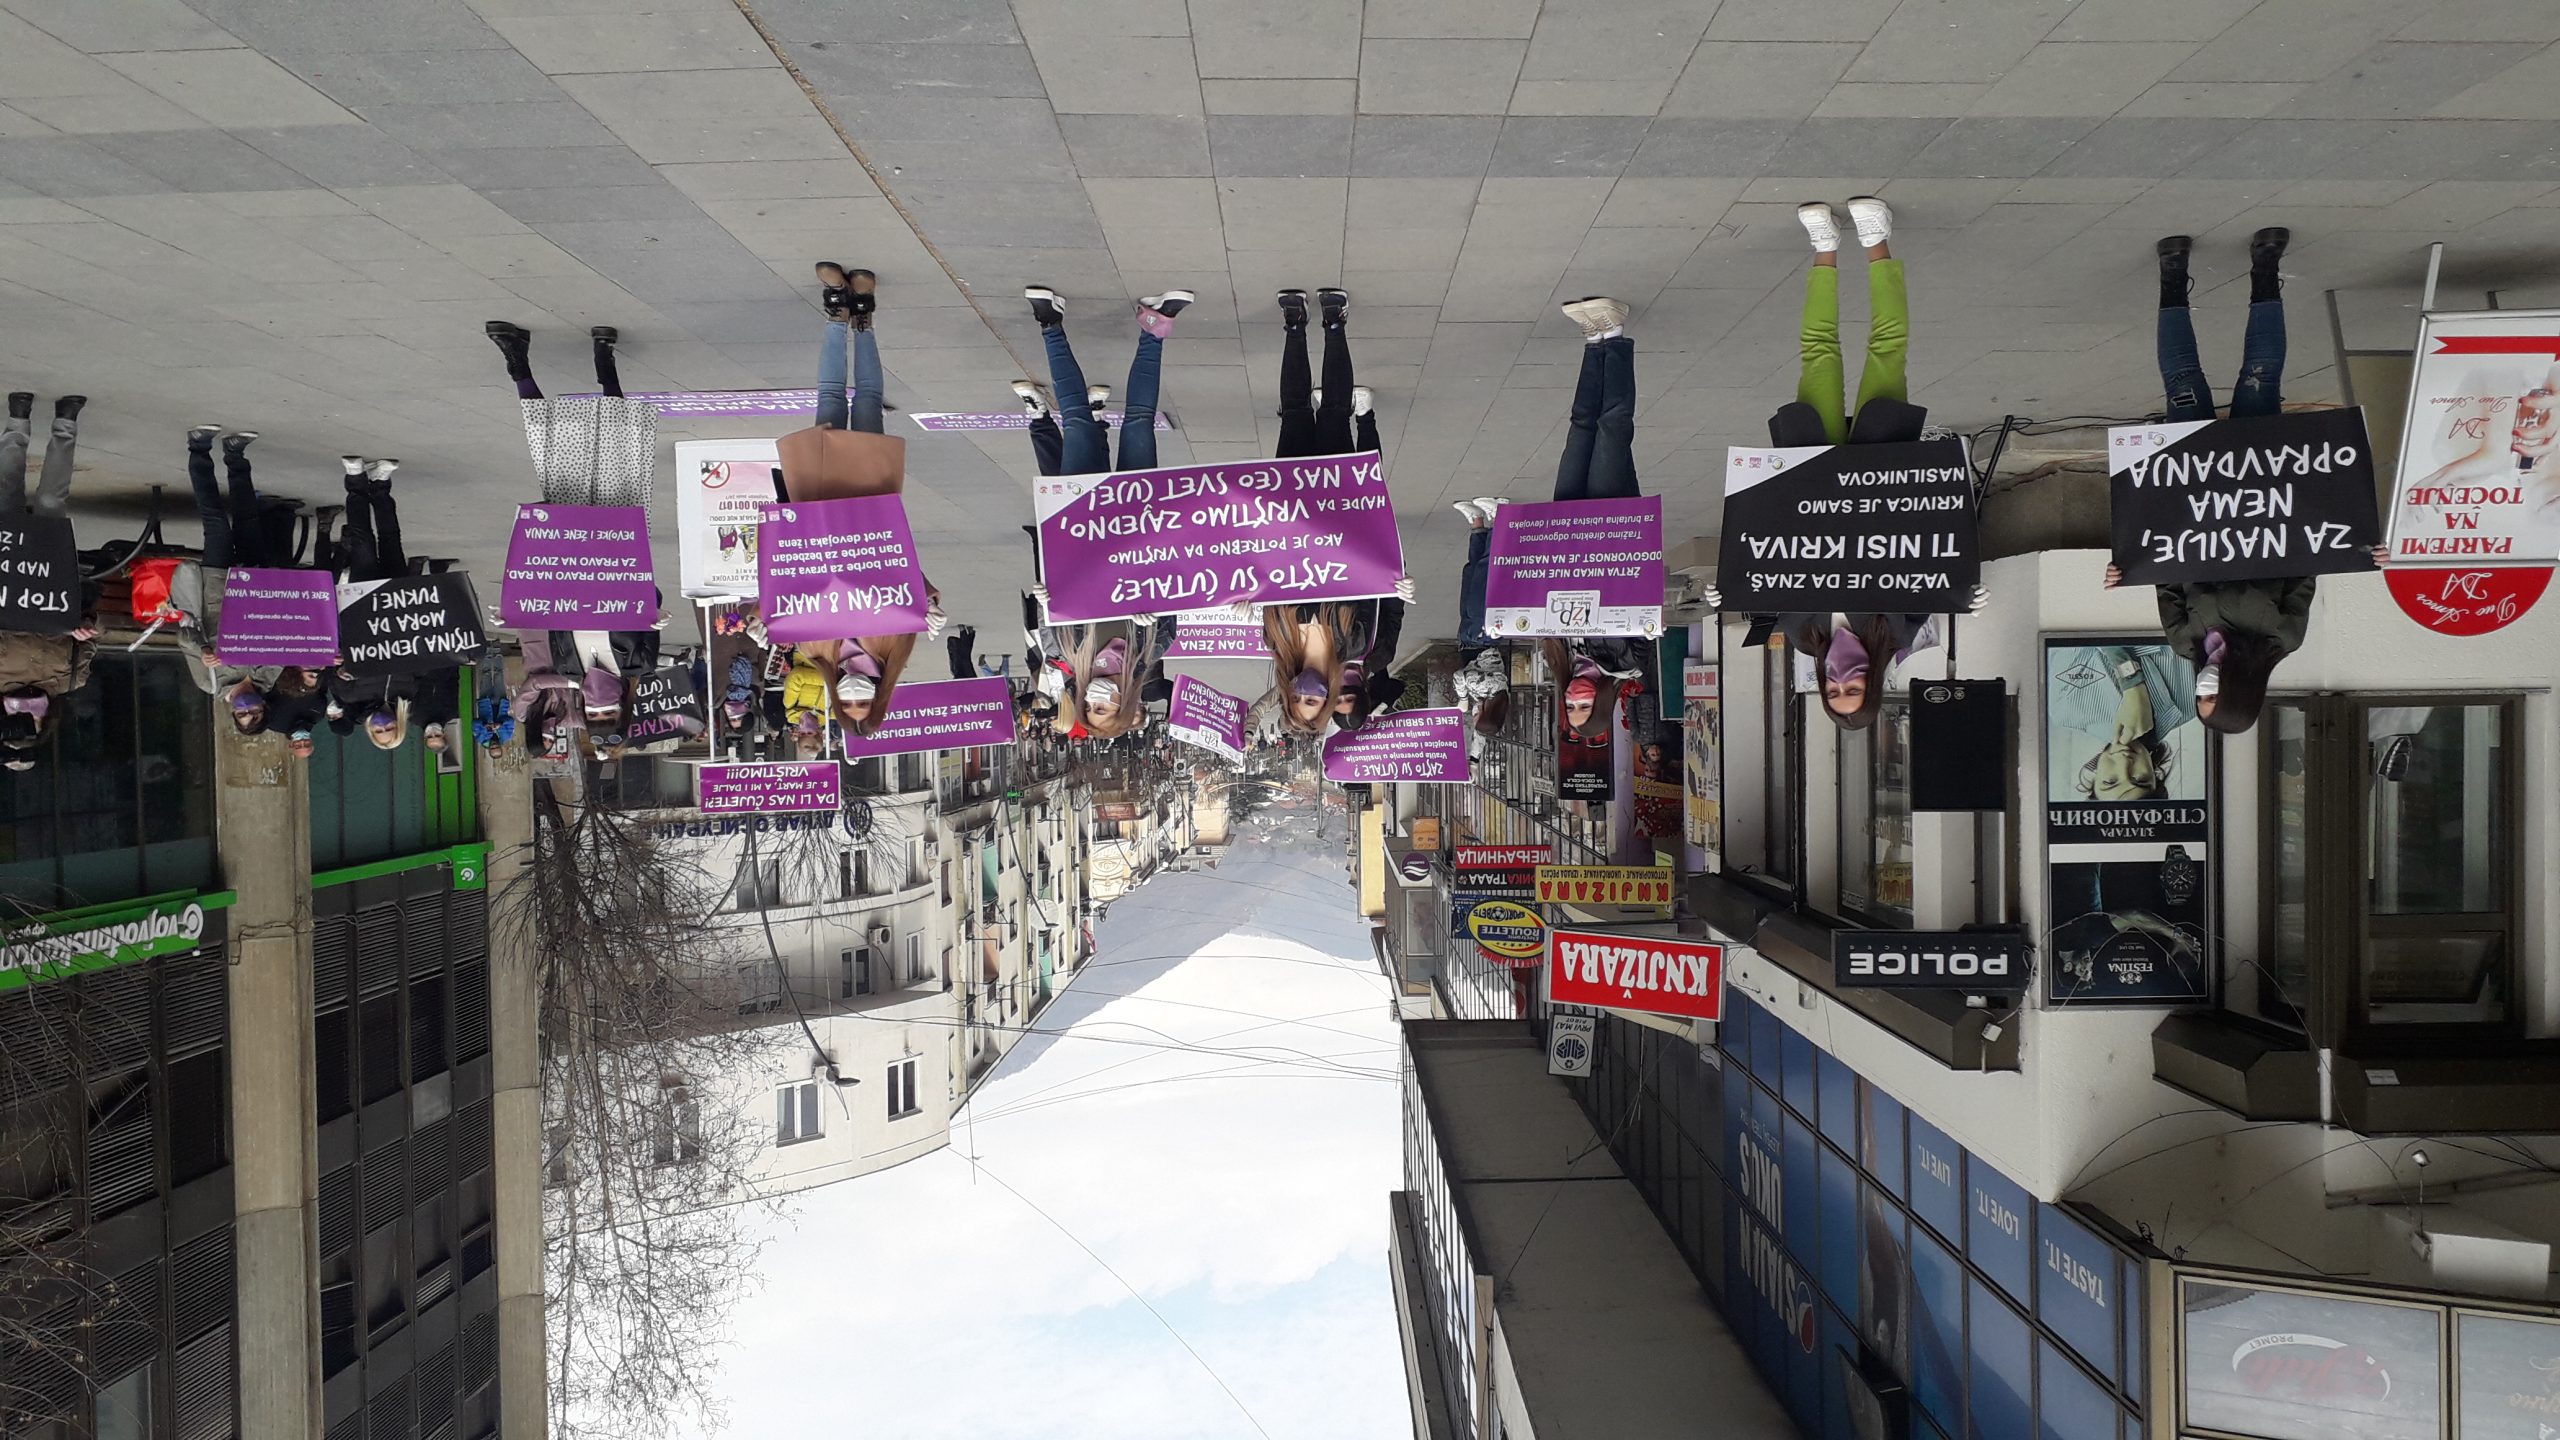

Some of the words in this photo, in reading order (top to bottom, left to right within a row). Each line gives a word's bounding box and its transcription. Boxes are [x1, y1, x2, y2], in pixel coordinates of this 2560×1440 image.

[2128, 442, 2356, 488] OPRAVDANJA
[1238, 467, 1282, 491] CEO
[1292, 464, 1340, 490] NAS
[1352, 462, 1382, 486] DA
[1837, 466, 1965, 486] NASILNIKOVA
[1158, 472, 1228, 501] SVET
[1088, 478, 1153, 510] ČUJE!
[2406, 486, 2524, 510] TOČENJE
[734, 500, 750, 510] 001
[1316, 498, 1335, 512] DA
[1342, 495, 1385, 510] HAJDE
[1797, 498, 1854, 514] SAMO
[1858, 498, 1882, 513] JE
[1886, 494, 1964, 512] KRIVICA
[2188, 483, 2292, 522] NEMA
[1192, 496, 1310, 528] VRIŠTIMO
[1060, 509, 1182, 540] ZAJEDNO,
[1508, 520, 1544, 529] devojaka
[1573, 516, 1603, 526] ubistva
[1606, 515, 1641, 524] brutalna
[2444, 512, 2479, 530] NA
[524, 528, 560, 540] VRANJA
[564, 529, 588, 542] ŽENE
[597, 530, 634, 540] DEVOJKE
[810, 532, 860, 548] devojaka
[1314, 532, 1343, 546] AKO
[1571, 532, 1605, 542] direktnu
[1608, 530, 1642, 540] Tražimo
[2304, 522, 2352, 554] ZA
[778, 539, 802, 549] žena
[1210, 536, 1286, 556] POTREBNO
[1292, 534, 1310, 549] JE
[1740, 532, 1846, 559] KRIVA,
[1857, 534, 1922, 559] NISI
[1932, 532, 1960, 558] TI
[2140, 524, 2286, 562] NASILJE,
[2400, 536, 2513, 555] PARFEMI
[825, 552, 838, 560] za
[841, 546, 876, 558] borbe
[878, 544, 902, 554] Dan
[1108, 545, 1178, 565] VRIŠTIMO
[1184, 544, 1203, 558] DA
[524, 556, 558, 565] ZIVOT
[561, 556, 576, 566] NA
[580, 557, 618, 566] PRAVO
[622, 558, 636, 566] ZA
[772, 552, 823, 564] bezbedan
[884, 557, 908, 568] Dan
[1494, 554, 1550, 565] NASILNIKU!
[1552, 554, 1566, 564] NA
[1582, 550, 1662, 563] ODGOVORNOST
[16, 560, 50, 578] NAD
[770, 567, 796, 578] žena
[798, 564, 827, 575] prava
[830, 564, 844, 572] za
[846, 560, 881, 572] borbe
[1548, 568, 1570, 578] NIJE
[1573, 568, 1604, 578] NIKAD
[1608, 566, 1640, 578] ŽRTVA
[506, 568, 534, 579] RAD,
[536, 572, 552, 580] NA
[556, 572, 594, 580] PRAVO
[598, 572, 652, 581] MENJAMO
[712, 574, 738, 582] DEVOJKE
[1230, 566, 1258, 592] SU
[1269, 558, 1348, 590] ZAŠTO
[1514, 569, 1546, 580] KRIVA!
[1847, 572, 1872, 589] JE
[1110, 568, 1218, 603] ĆUTALE?
[1745, 570, 1806, 592] ZNAŠ,
[1811, 574, 1840, 589] DA
[1878, 572, 1950, 592] VAŽNO
[18, 588, 68, 612] STOP
[250, 590, 300, 599] INVALIDITETOM
[372, 585, 440, 612] PUKNE!
[847, 582, 913, 614] SREĆAN
[514, 598, 550, 616] ŽENA.
[554, 600, 578, 612] DAN
[592, 600, 628, 614] MART
[770, 593, 820, 618] MART
[367, 616, 391, 636] DA
[396, 608, 446, 632] MORA
[1226, 628, 1246, 636] NIJE
[424, 627, 480, 653] TIŠINA
[1180, 640, 1214, 652] ŽENA
[1218, 640, 1245, 650] DAN
[350, 635, 420, 662] JEDNOM
[658, 694, 695, 712] DOSTA
[1180, 690, 1208, 706] OSTATI
[641, 700, 656, 714] JE
[918, 706, 948, 716] ŽENA
[950, 702, 1004, 714] UBIJANJE
[924, 720, 992, 734] ZAUSTAVIMO
[1435, 716, 1458, 726] ŽENE
[726, 766, 808, 782] VRIŠTIMO!!!
[1362, 762, 1398, 780] ĆUTALE
[1416, 759, 1443, 778] ZAŠTO
[712, 784, 742, 792] DALJE
[704, 794, 764, 810] ČUJETE?!
[768, 794, 795, 806] NAS
[800, 794, 811, 804] LI
[816, 792, 834, 804] DA
[2049, 808, 2206, 826] СТЕФАНОВИЋ
[2100, 827, 2155, 837] ЗЛАТАРА
[1456, 849, 1552, 864] МЕЊАЧНИЦА
[1472, 908, 1492, 918] BETS
[32, 923, 46, 936] otp
[1482, 926, 1540, 936] ROULETTE
[1560, 942, 1709, 999] KNJIŽARA
[1850, 952, 2008, 976] POLICE
[2108, 962, 2154, 972] FESTINA
[1574, 1024, 1592, 1032] PRVI
[1932, 1154, 1950, 1188] LIVE
[1992, 1199, 2018, 1240] LOVE
[2063, 1252, 2104, 1308] TASTE
[2248, 1334, 2294, 1350] PROMET
